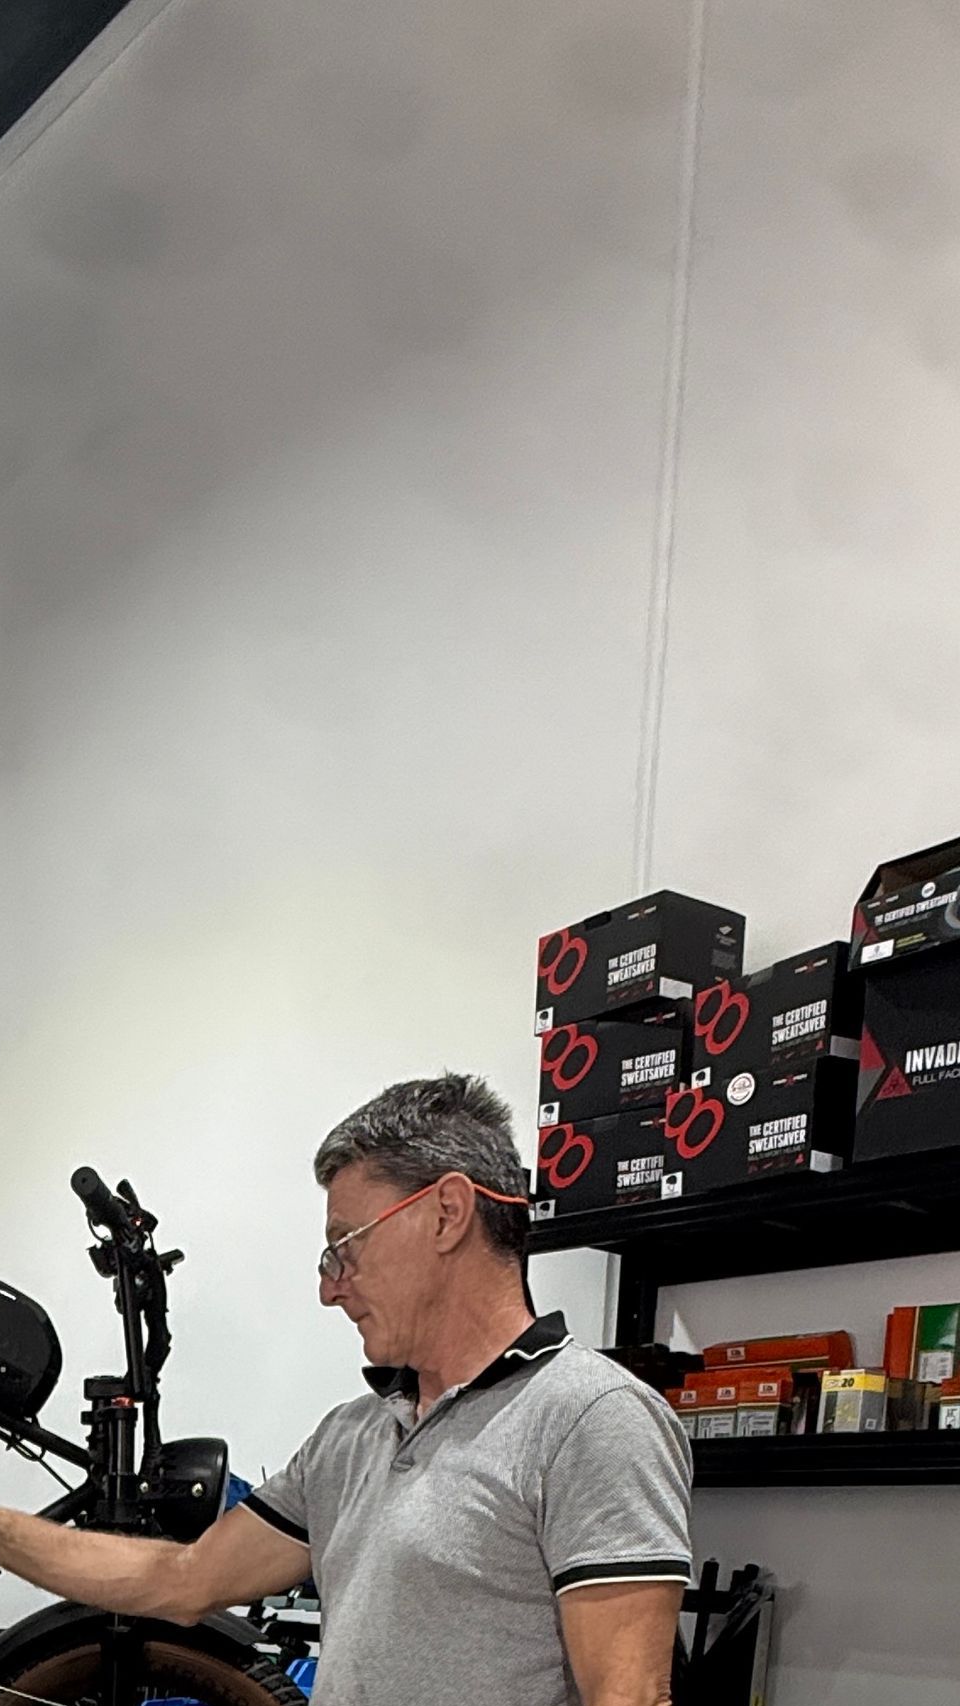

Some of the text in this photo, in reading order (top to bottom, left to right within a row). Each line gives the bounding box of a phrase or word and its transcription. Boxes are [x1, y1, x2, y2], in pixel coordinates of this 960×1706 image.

[619, 943, 657, 968] CERTIFIED
[607, 958, 656, 986] SWEATSAVER
[784, 999, 827, 1026] CERTIFIED
[772, 1015, 826, 1045] SWEATSAVER
[634, 1049, 676, 1070] CERTIFIED
[905, 1041, 960, 1074] INVAD
[621, 1063, 675, 1086] SWEATSAVER
[912, 1074, 937, 1086] FULL
[762, 1113, 807, 1136] CERTIFIED
[748, 1129, 806, 1154] SWEATSAVER
[841, 1378, 855, 1388] 20
